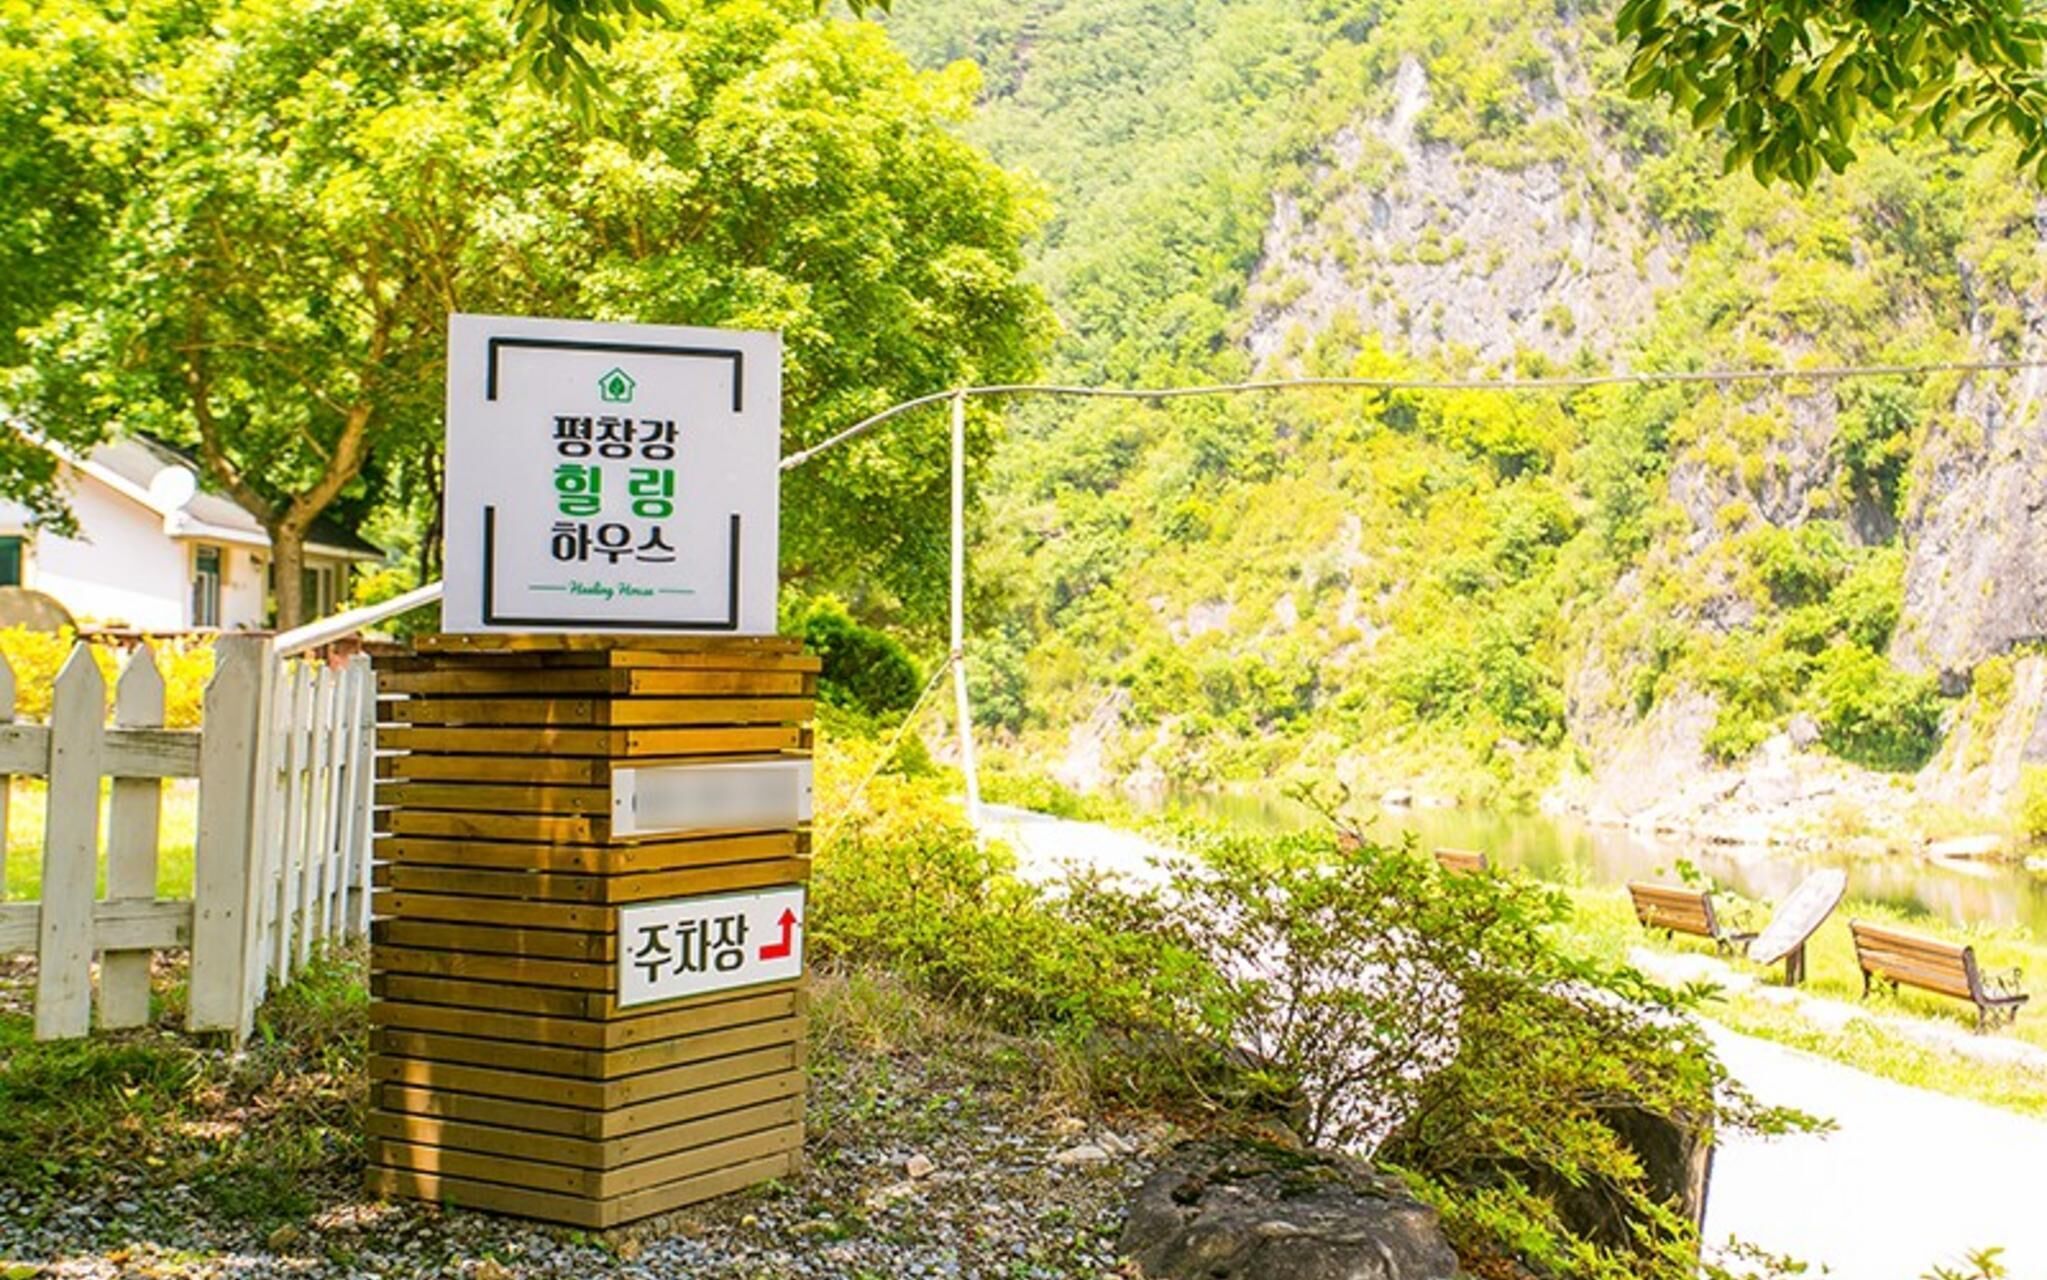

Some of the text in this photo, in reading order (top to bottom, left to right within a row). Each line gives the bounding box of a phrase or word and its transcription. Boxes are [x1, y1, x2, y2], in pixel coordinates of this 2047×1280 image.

[552, 415, 679, 460] 평창강
[551, 521, 676, 564] 하우스
[568, 580, 654, 600] Healing House
[634, 914, 749, 983] 주차장
